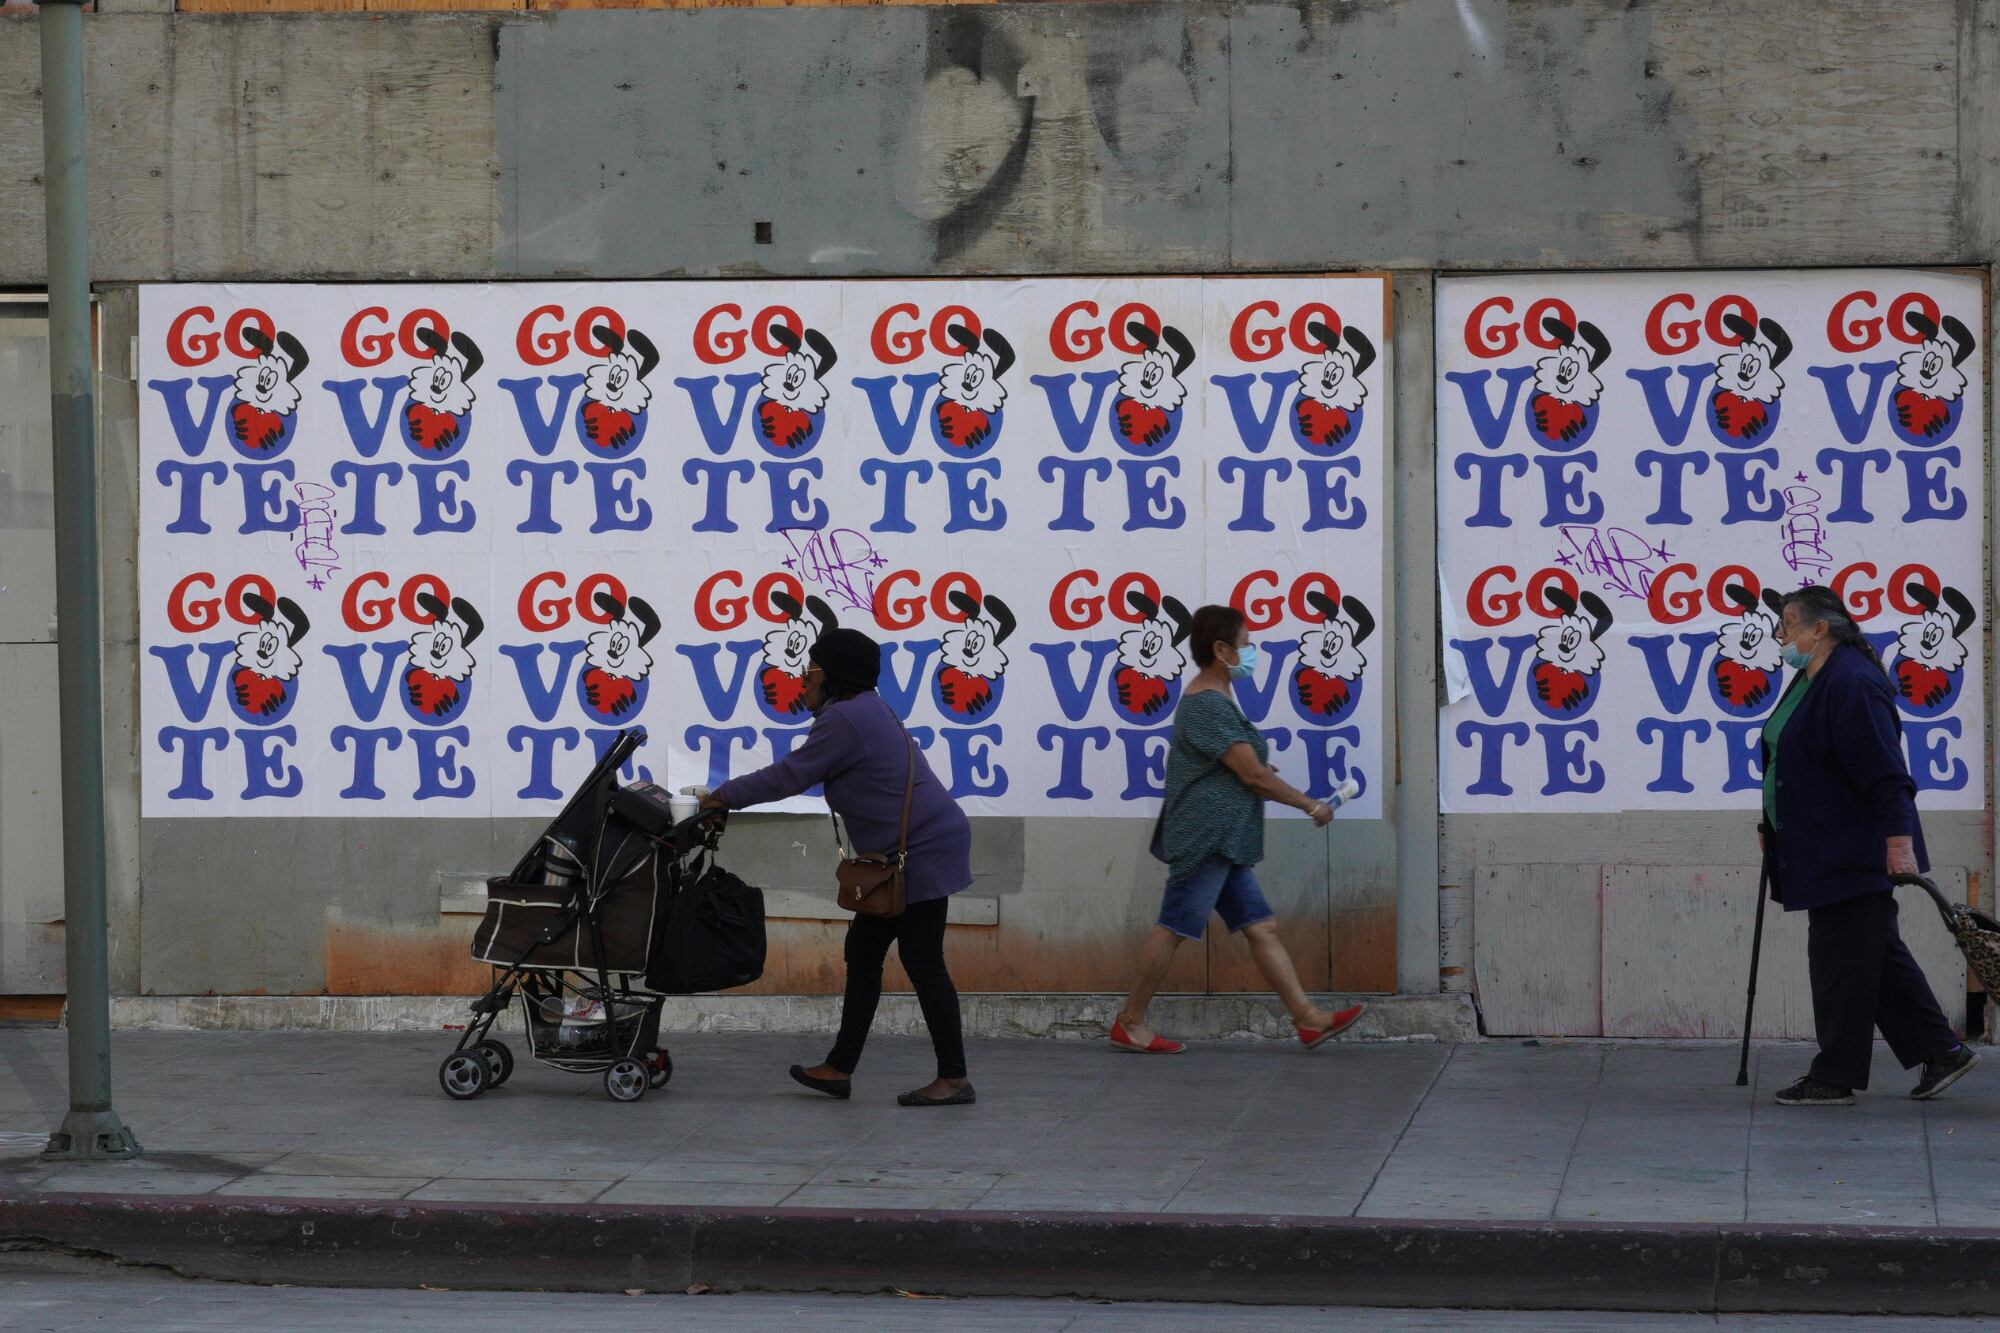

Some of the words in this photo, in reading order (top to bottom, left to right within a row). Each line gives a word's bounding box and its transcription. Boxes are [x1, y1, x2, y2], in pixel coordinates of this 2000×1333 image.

[168, 306, 275, 367] GO
[342, 308, 450, 367] GO
[517, 305, 625, 365] GO
[694, 304, 803, 364] GO
[872, 304, 981, 364] GO
[1050, 301, 1160, 361] GO
[1230, 301, 1341, 362] GO
[1465, 297, 1576, 358] GO
[1646, 294, 1757, 354] GO
[1828, 292, 1939, 352] GO
[157, 459, 301, 535] TE
[331, 459, 476, 535] TE
[507, 458, 652, 534] TE
[682, 457, 829, 533] TE
[860, 457, 1007, 533] TE
[1039, 456, 1186, 532] TE
[1219, 456, 1367, 533] TE
[1455, 450, 1605, 528] TE
[1635, 448, 1786, 525] TE
[1816, 446, 1968, 523] TE
[167, 572, 275, 633] GO
[341, 571, 450, 632] GO
[517, 571, 626, 632] GO
[694, 570, 804, 631] GO
[872, 569, 982, 631] GO
[1049, 569, 1160, 630] GO
[1229, 569, 1341, 631] GO
[1466, 565, 1578, 626] GO
[1647, 563, 1760, 624] GO
[1830, 562, 1941, 622] GO
[158, 725, 303, 800] TE
[331, 725, 475, 800] TE
[907, 725, 1009, 799] E
[1264, 726, 1368, 800] E
[1456, 719, 1605, 796] TE
